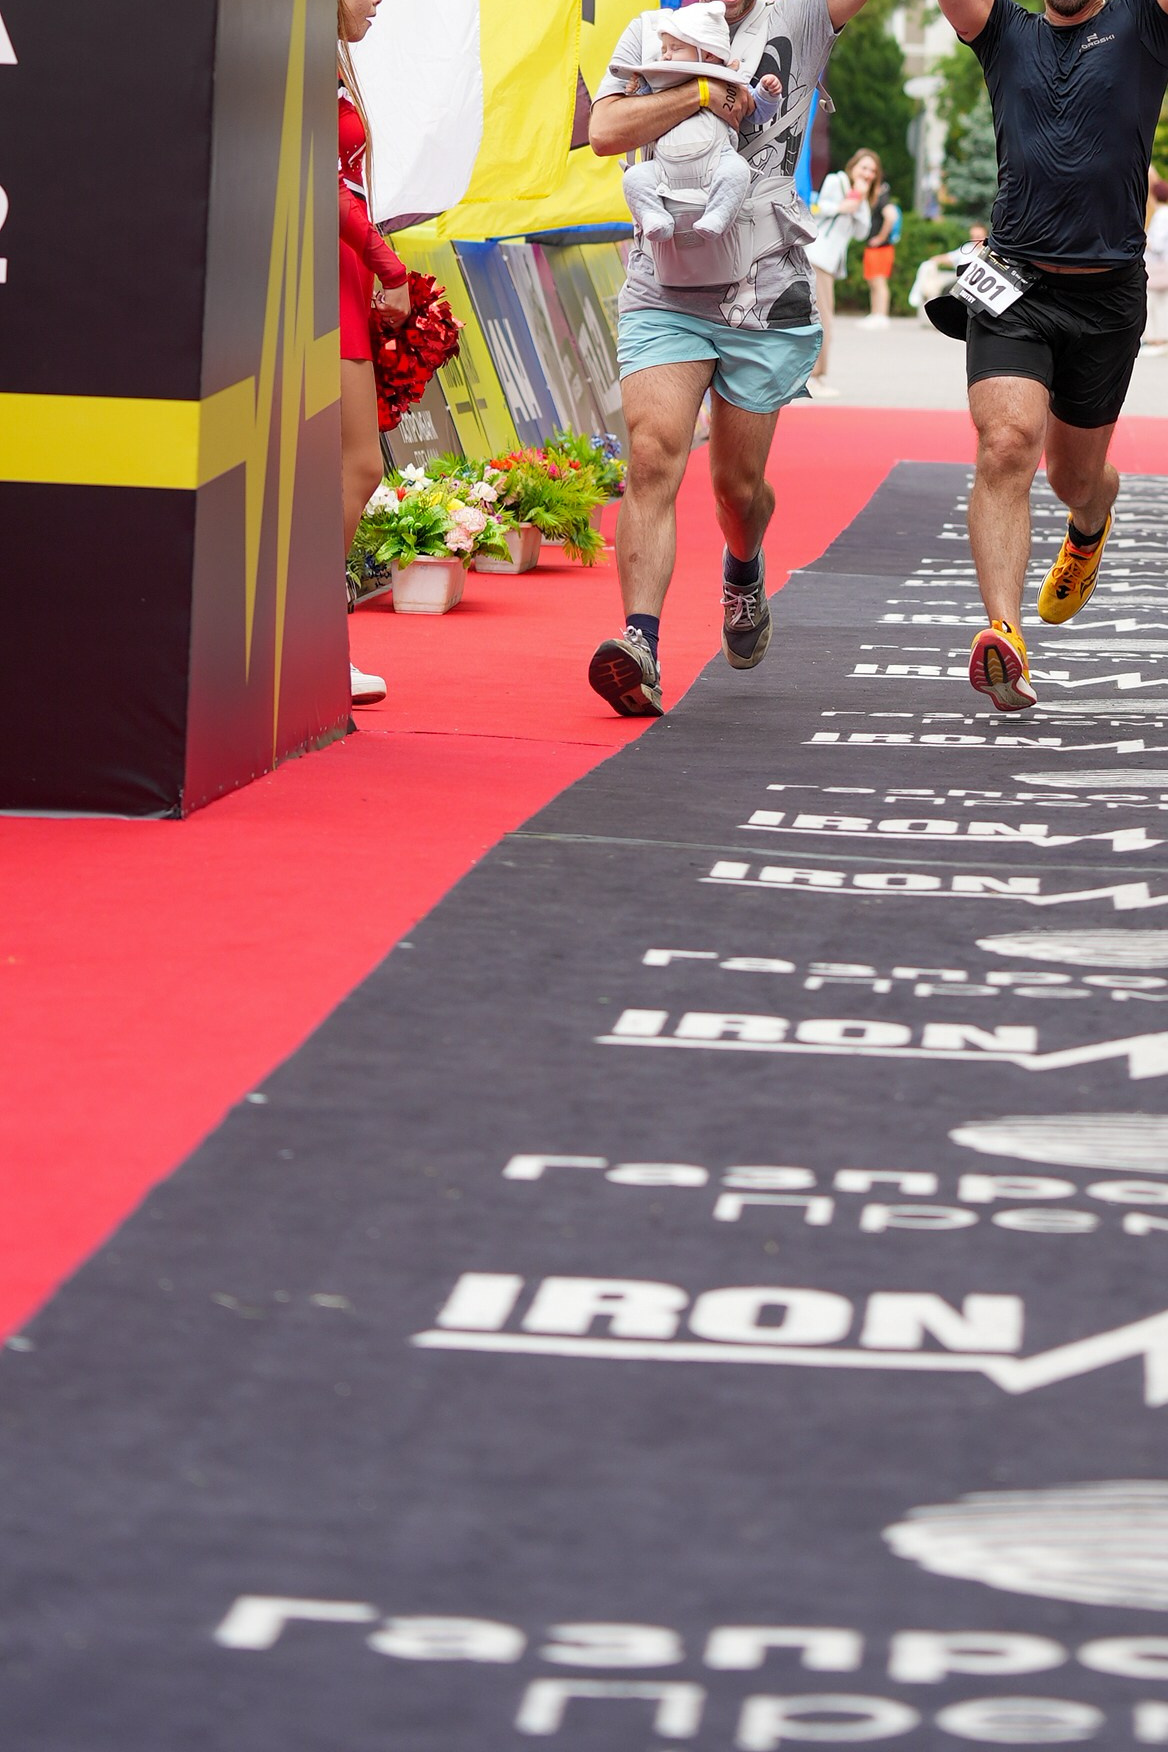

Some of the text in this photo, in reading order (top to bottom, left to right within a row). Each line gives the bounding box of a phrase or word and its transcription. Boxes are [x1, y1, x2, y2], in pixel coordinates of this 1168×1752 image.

[809, 732, 1063, 747] IRON
[746, 810, 1049, 836] IRON
[708, 860, 1042, 894] IRON
[609, 1008, 1038, 1051] IRON
[435, 1272, 1026, 1354] IRON
